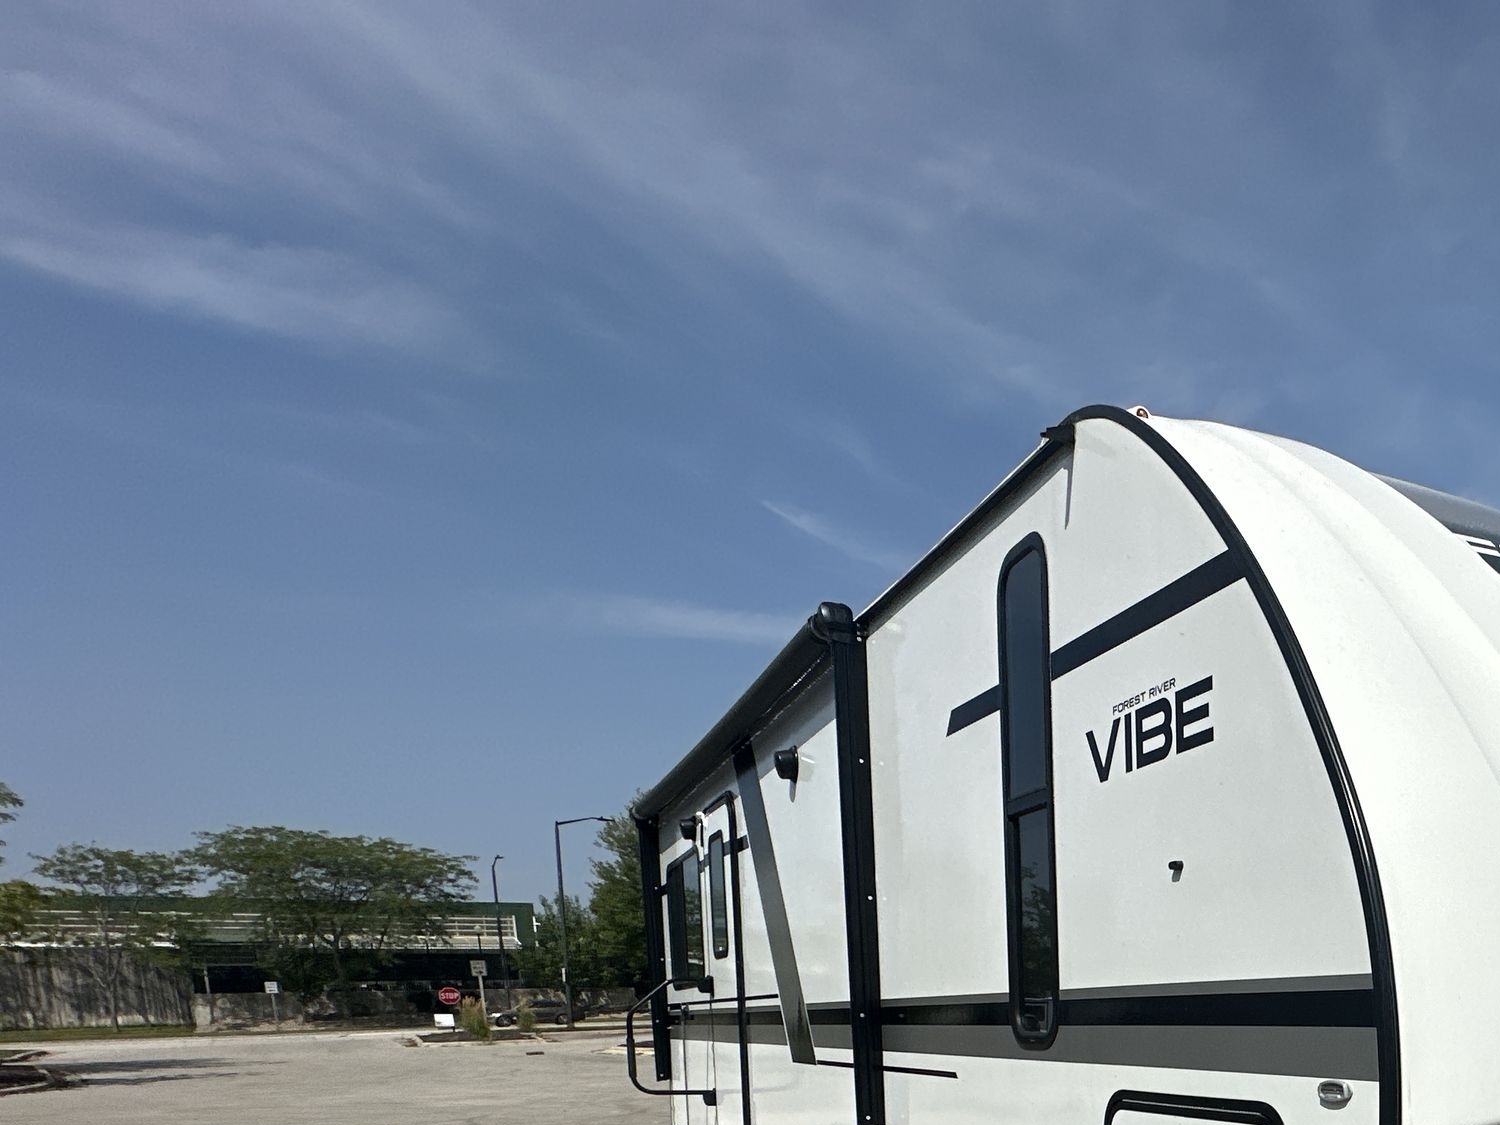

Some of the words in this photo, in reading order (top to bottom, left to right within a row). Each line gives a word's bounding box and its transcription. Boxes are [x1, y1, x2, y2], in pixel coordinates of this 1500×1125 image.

[1112, 691, 1147, 716] FOREST
[1149, 677, 1176, 699] RIVER
[1085, 675, 1215, 783] VIBE
[440, 992, 459, 1000] STOP
